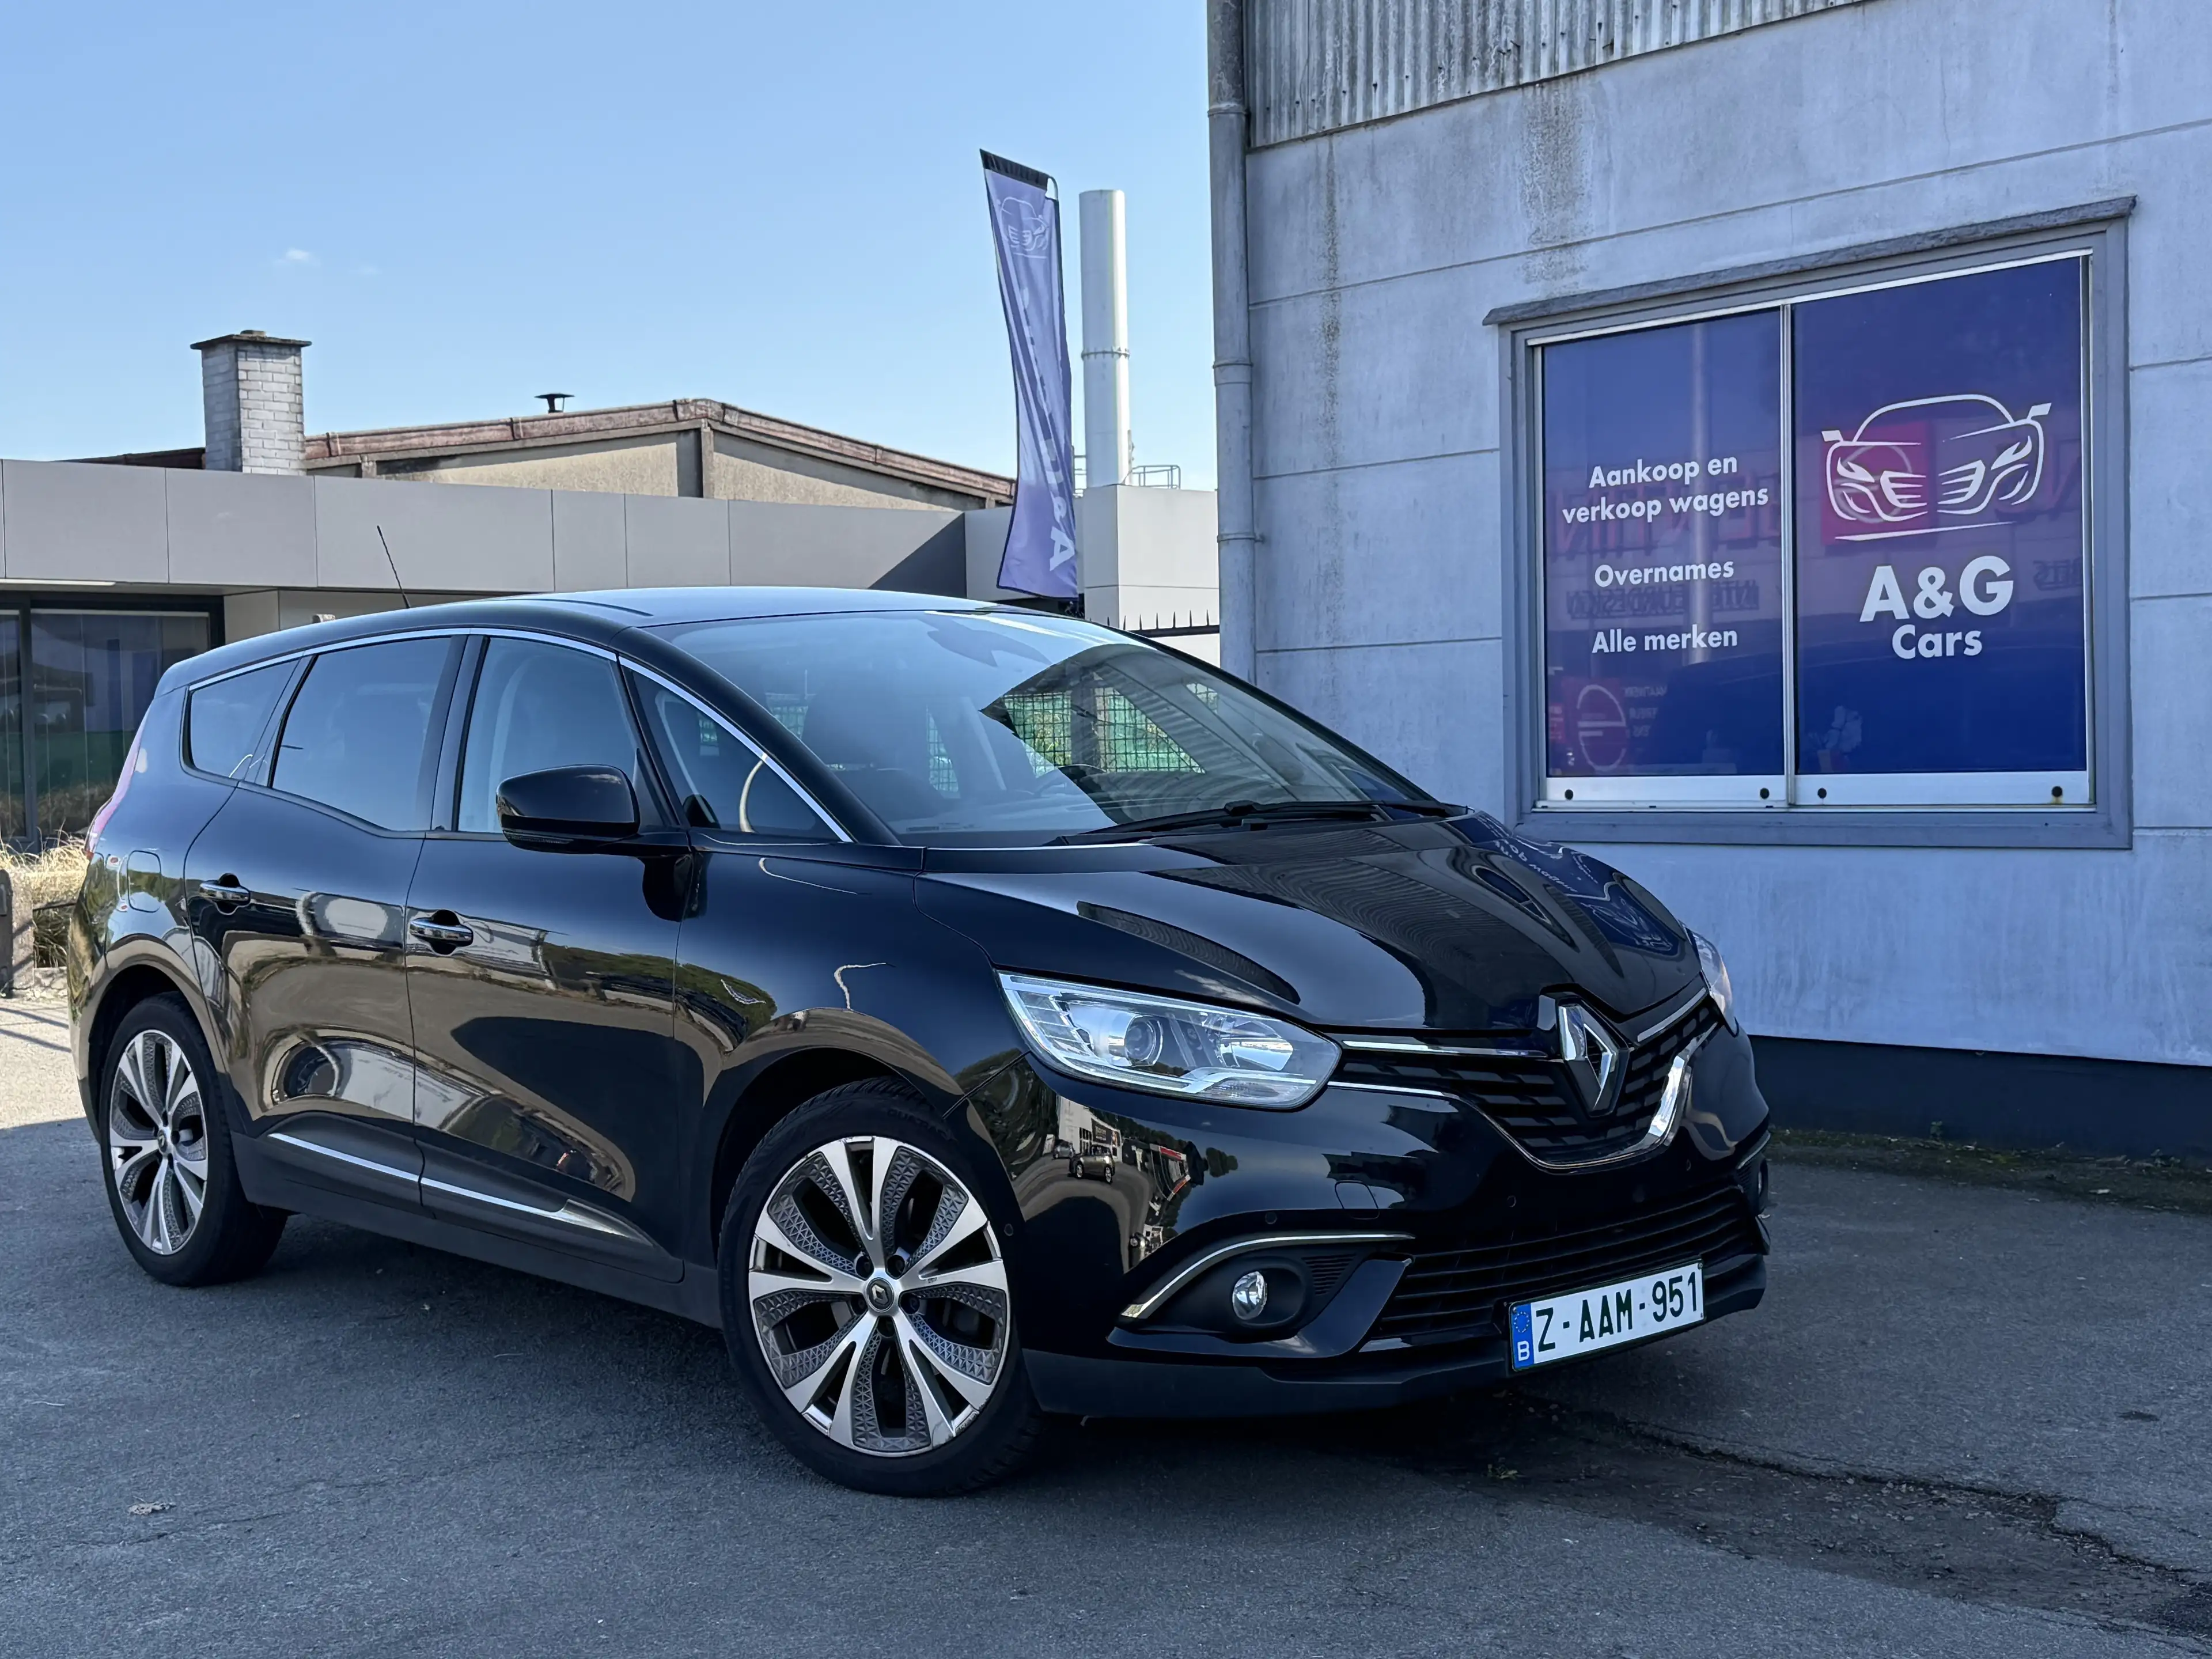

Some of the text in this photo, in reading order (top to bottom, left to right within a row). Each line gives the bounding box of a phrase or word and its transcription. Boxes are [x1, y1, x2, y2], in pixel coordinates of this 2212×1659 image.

[1589, 457, 1737, 488] Aankoop en
[1562, 488, 1768, 524] verkoop wagens
[1594, 561, 1736, 588] Overnames
[1859, 555, 2013, 622] A&G
[1592, 624, 1737, 653] Alle merken
[1892, 624, 1982, 659] Cars
[1535, 1271, 1697, 1353] Z-AAM-951
[1517, 1340, 1530, 1362] B
